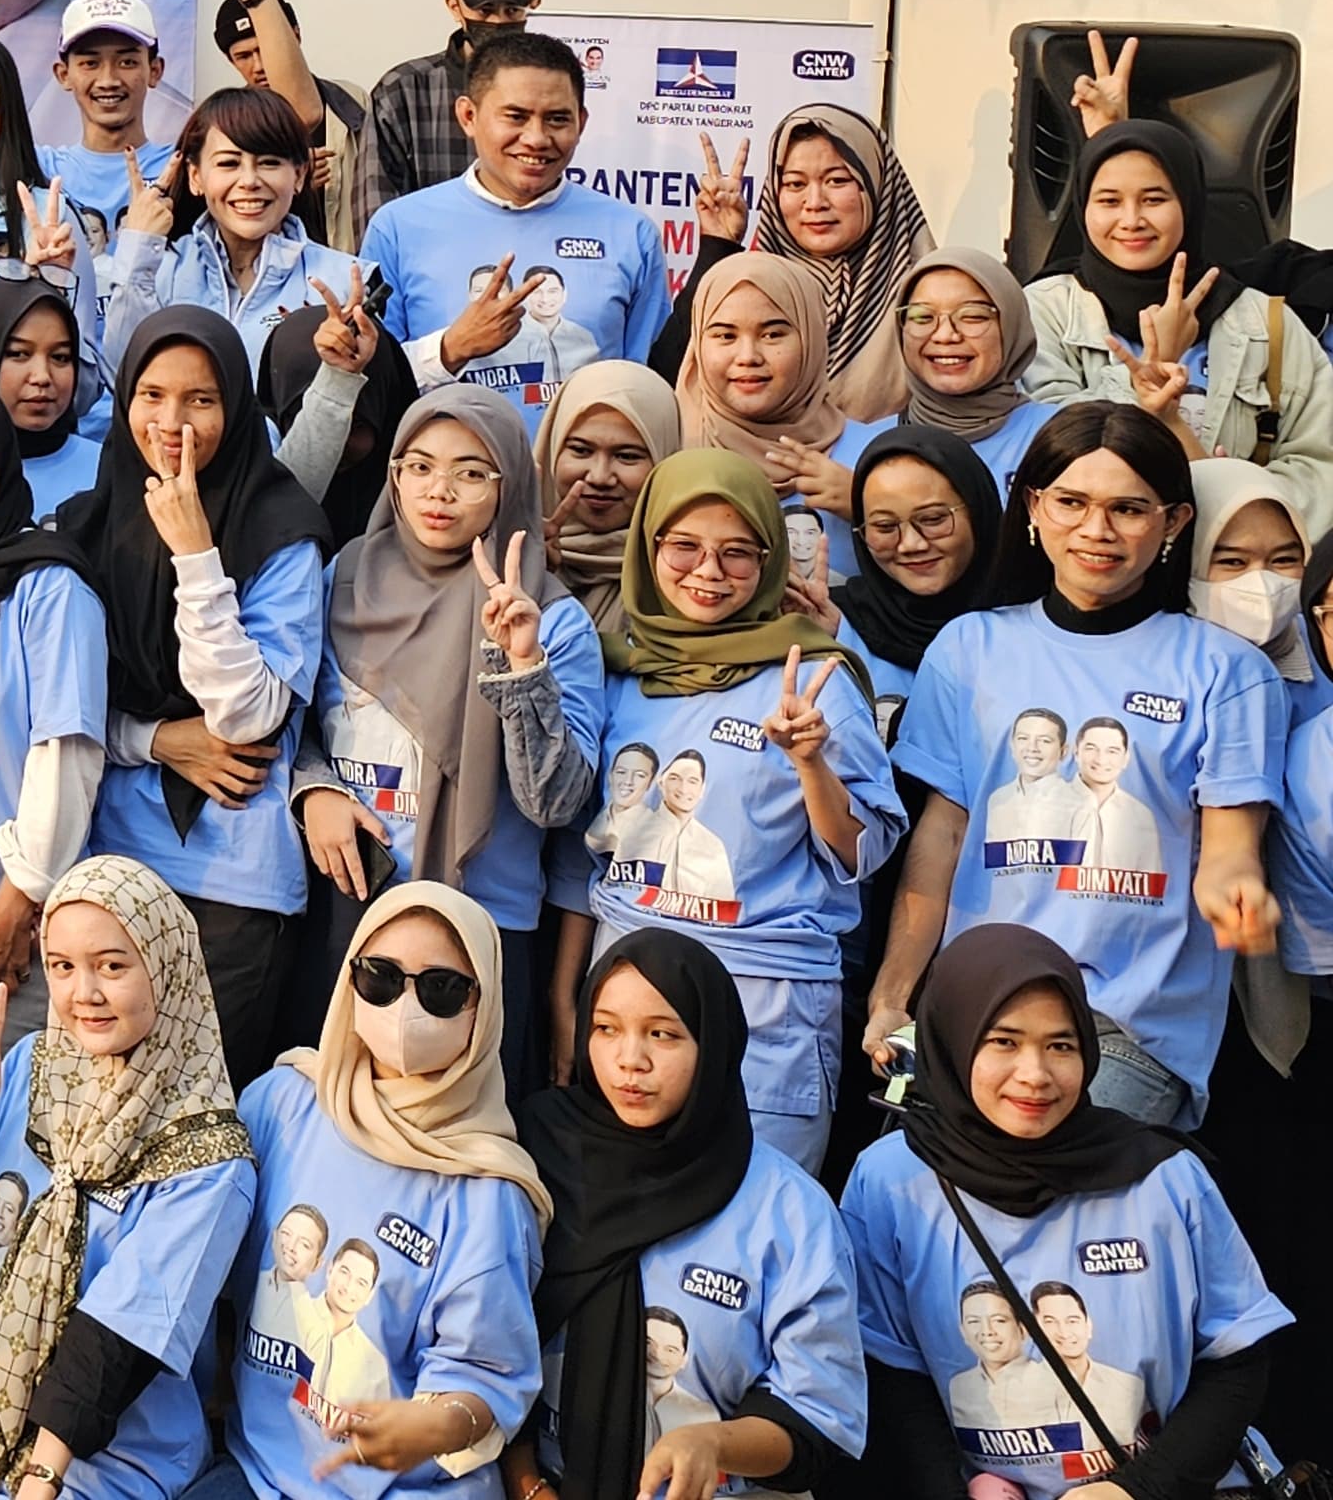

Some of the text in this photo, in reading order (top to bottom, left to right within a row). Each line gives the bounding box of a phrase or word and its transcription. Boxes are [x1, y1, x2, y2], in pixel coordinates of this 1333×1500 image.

[801, 52, 848, 67] CNW
[796, 66, 849, 78] BANTEN
[639, 102, 752, 114] DPC PARTAI DEMOKRAT
[637, 115, 754, 129] KABUPATEN TANGERANG
[558, 249, 602, 259] BANTEN
[560, 239, 600, 251] CNW
[1125, 701, 1182, 723] BANTEN
[1132, 693, 1182, 713] CNW
[711, 729, 763, 751] BANTEN
[719, 719, 766, 741] CNW
[1075, 866, 1151, 896] DIMYATI
[654, 887, 719, 921] DIMYATI
[388, 1217, 434, 1252] CNW
[377, 1226, 431, 1268] BANTEN
[1085, 1241, 1137, 1261] CNW
[1084, 1257, 1144, 1273] BANTEN
[692, 1268, 743, 1295] CNW
[683, 1279, 742, 1309] BANTEN
[978, 1426, 1055, 1458] ANDRA
